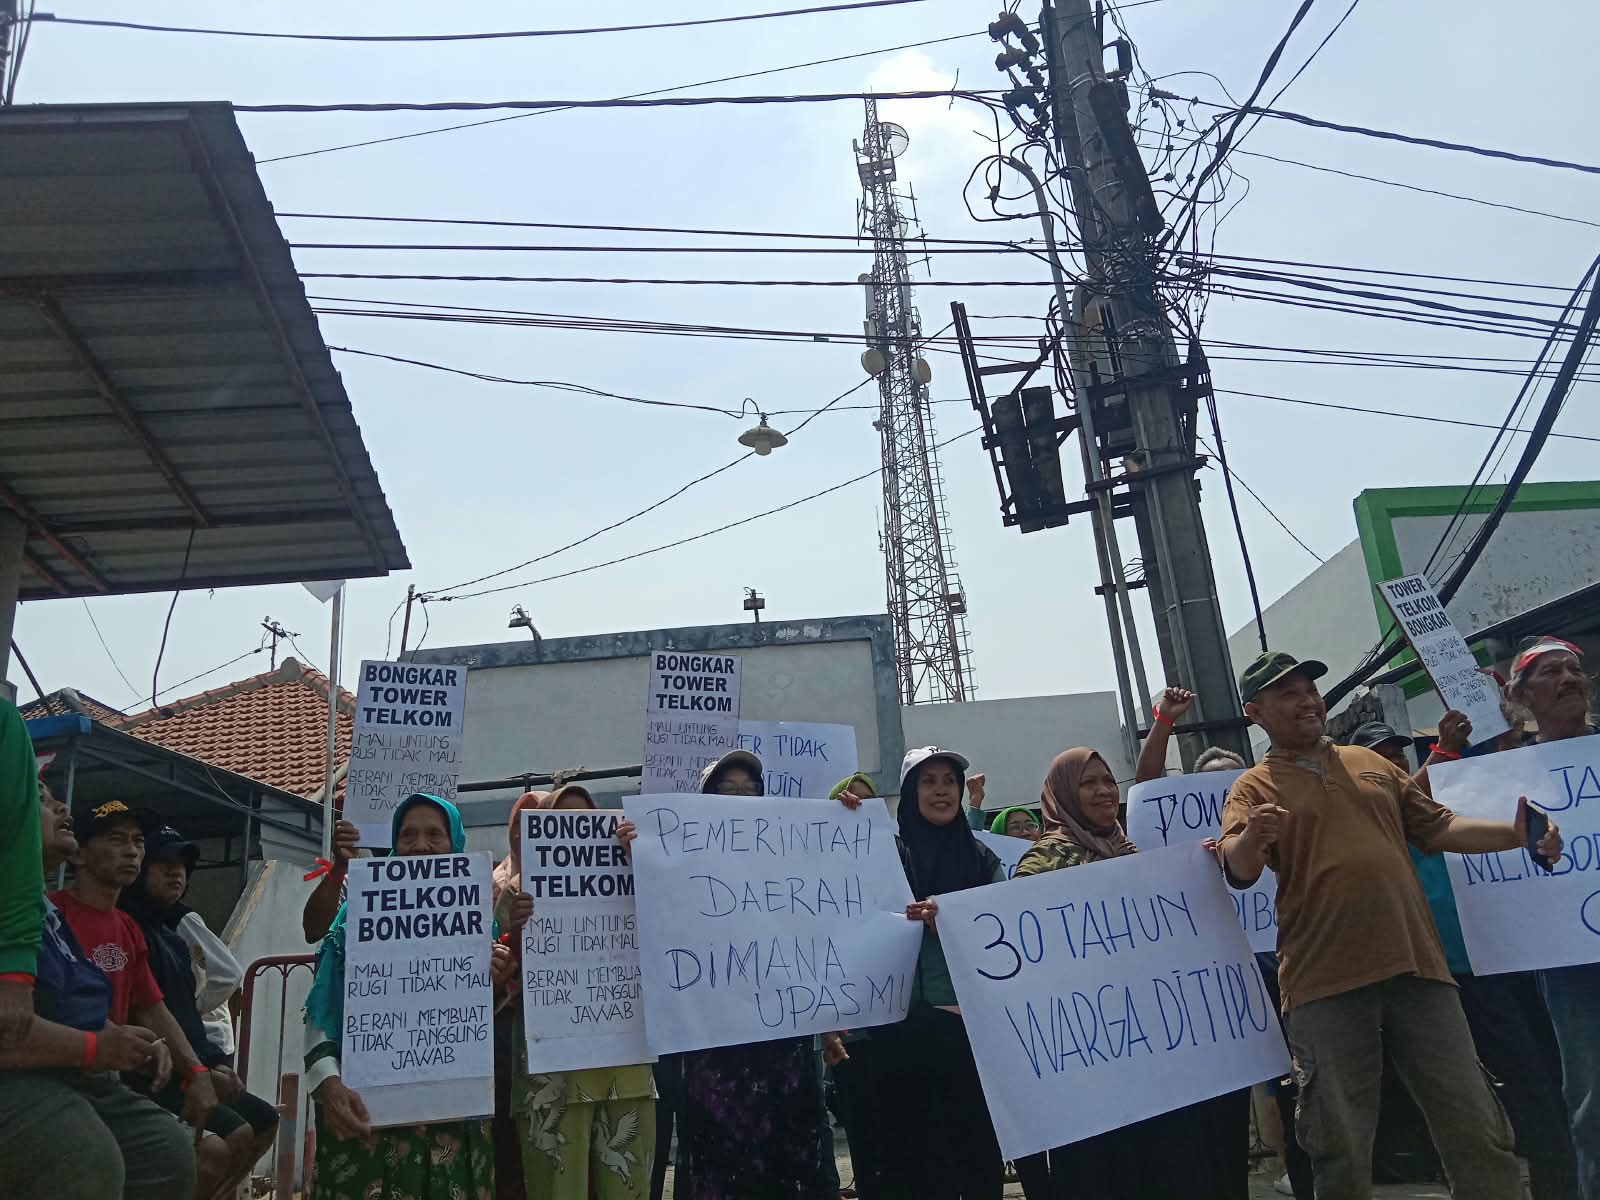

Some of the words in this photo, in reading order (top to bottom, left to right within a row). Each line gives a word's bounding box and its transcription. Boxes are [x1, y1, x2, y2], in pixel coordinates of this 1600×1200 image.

[1387, 577, 1426, 600] TOWER
[1397, 595, 1439, 618] TELKOM
[1405, 611, 1452, 637] BONGKAR
[365, 664, 458, 687] BONGKAR
[656, 655, 735, 674] BONGKAR
[660, 675, 727, 693] TOWER
[369, 686, 448, 706] TOWER
[656, 693, 732, 712] TELKOM
[363, 707, 452, 727] TELKOM
[400, 735, 450, 750] UNTUNG
[671, 733, 705, 746] TIDAK
[773, 734, 829, 762] TIDAK
[352, 746, 376, 760] RUGI
[380, 747, 421, 762] TIDAK
[429, 750, 456, 763] MAU
[349, 769, 393, 784] BERANI
[401, 772, 460, 787] MEMBUAT
[646, 767, 677, 779] TIDAK
[685, 768, 701, 779] TA
[352, 783, 389, 798] TIDAK
[672, 780, 700, 792] JAW
[369, 798, 400, 811] JAW
[527, 815, 626, 840] BONGKA
[1143, 788, 1229, 847] TOW
[535, 845, 629, 868] TOWER
[367, 856, 471, 883] TOWER
[530, 874, 635, 898] TELKOM
[689, 873, 863, 918] DAERAH
[361, 884, 480, 913] TELKOM
[358, 910, 483, 943] BONGKAR
[530, 917, 563, 935] MAU
[574, 914, 635, 934] UNTUNG
[1046, 891, 1199, 960] TAHUN
[526, 935, 560, 954] RUGI
[571, 934, 609, 953] TIDAK
[354, 962, 392, 979] MAU
[409, 956, 474, 976] UNTUNG
[527, 969, 578, 989] BERANI
[587, 966, 642, 986] MEMBUA
[348, 979, 387, 998] RUGI
[398, 975, 447, 993] TIDAK
[455, 972, 492, 989] MAU
[529, 988, 573, 1008] TIDAK
[586, 983, 643, 1003] TANGGU
[347, 1011, 407, 1034] BERANI
[418, 1005, 487, 1027] MEMBUAT
[571, 1001, 634, 1025] JAWAB
[351, 1032, 394, 1053] TIDAK
[407, 1024, 488, 1048] TANGGUNG
[1004, 983, 1153, 1080] WARGA
[391, 1046, 456, 1070] JAWAB
